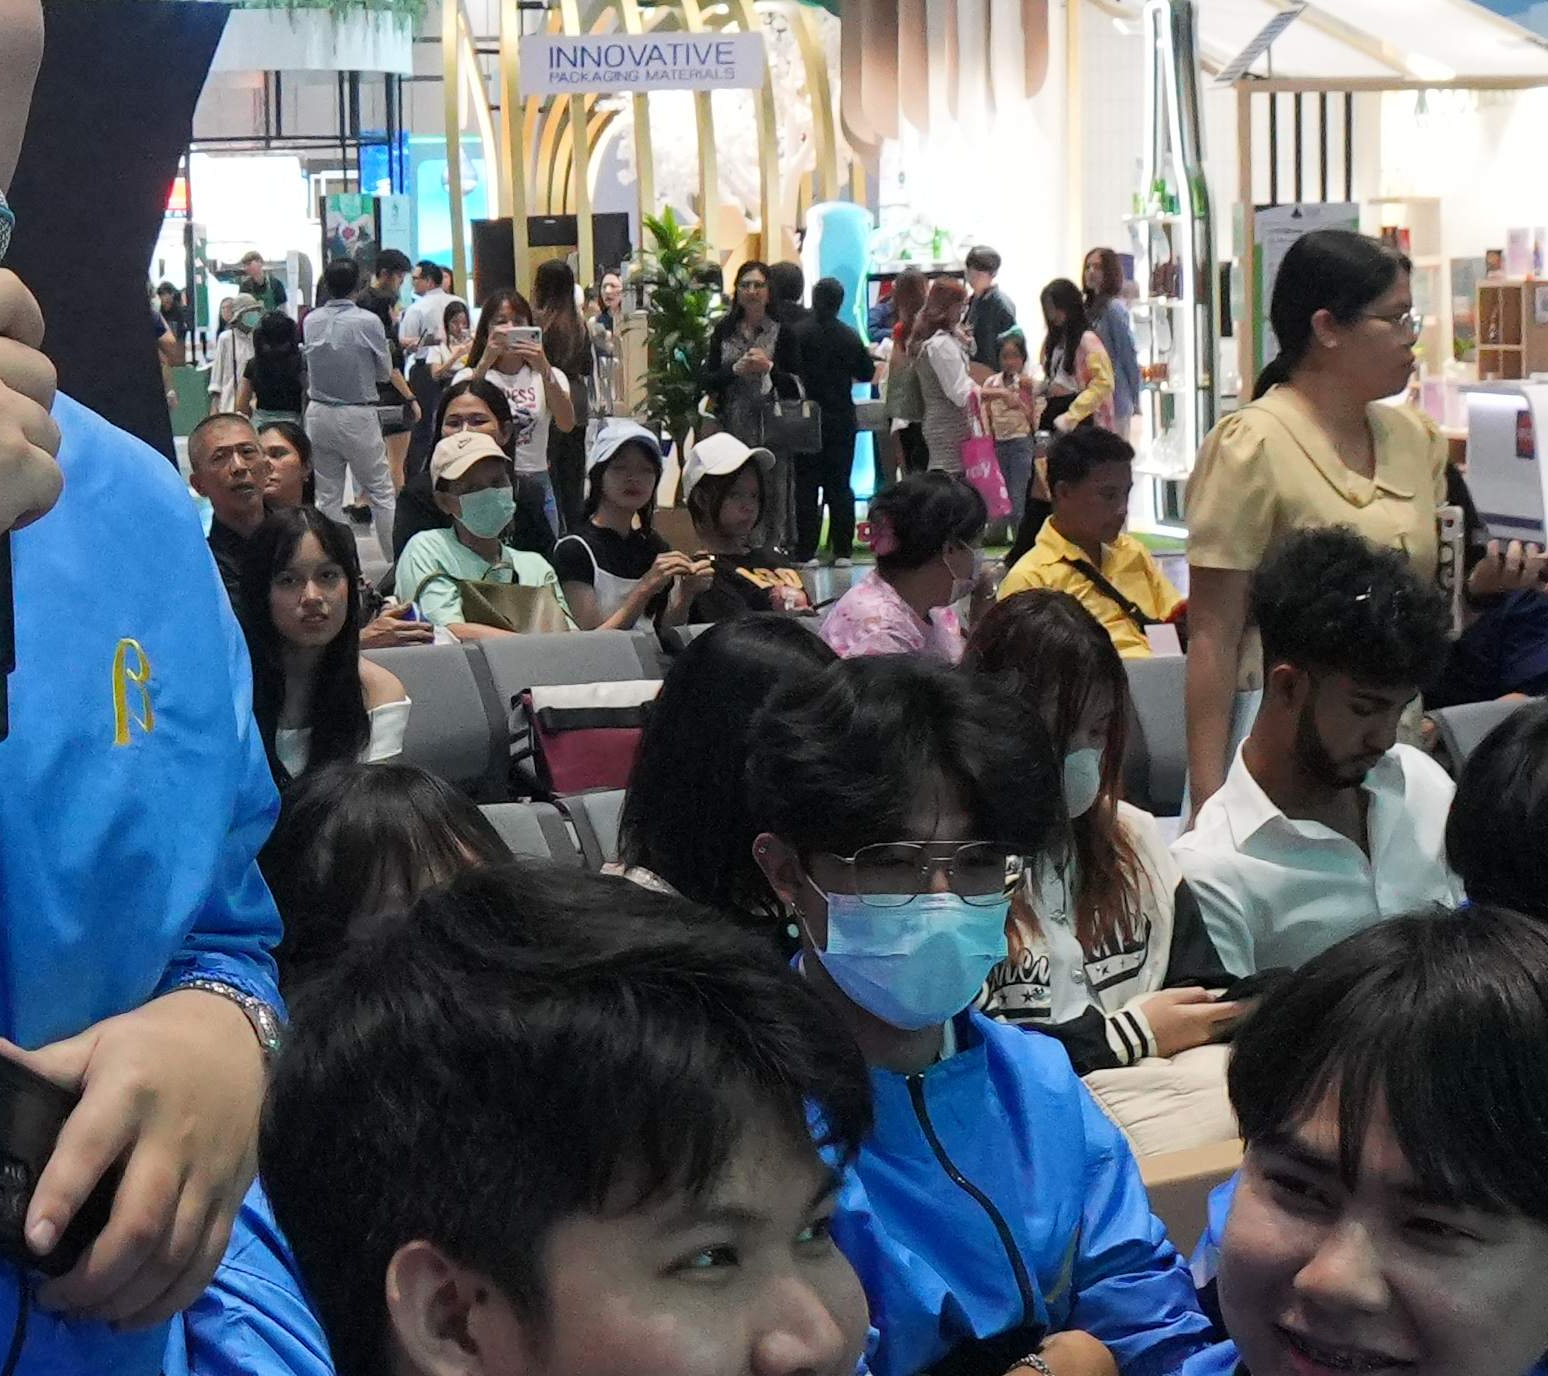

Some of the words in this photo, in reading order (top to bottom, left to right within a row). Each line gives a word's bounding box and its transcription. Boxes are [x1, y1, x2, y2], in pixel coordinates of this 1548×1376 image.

[549, 41, 736, 69] INNOVATIVE
[549, 70, 639, 84] PACKAGING
[645, 67, 736, 81] MATERIALS
